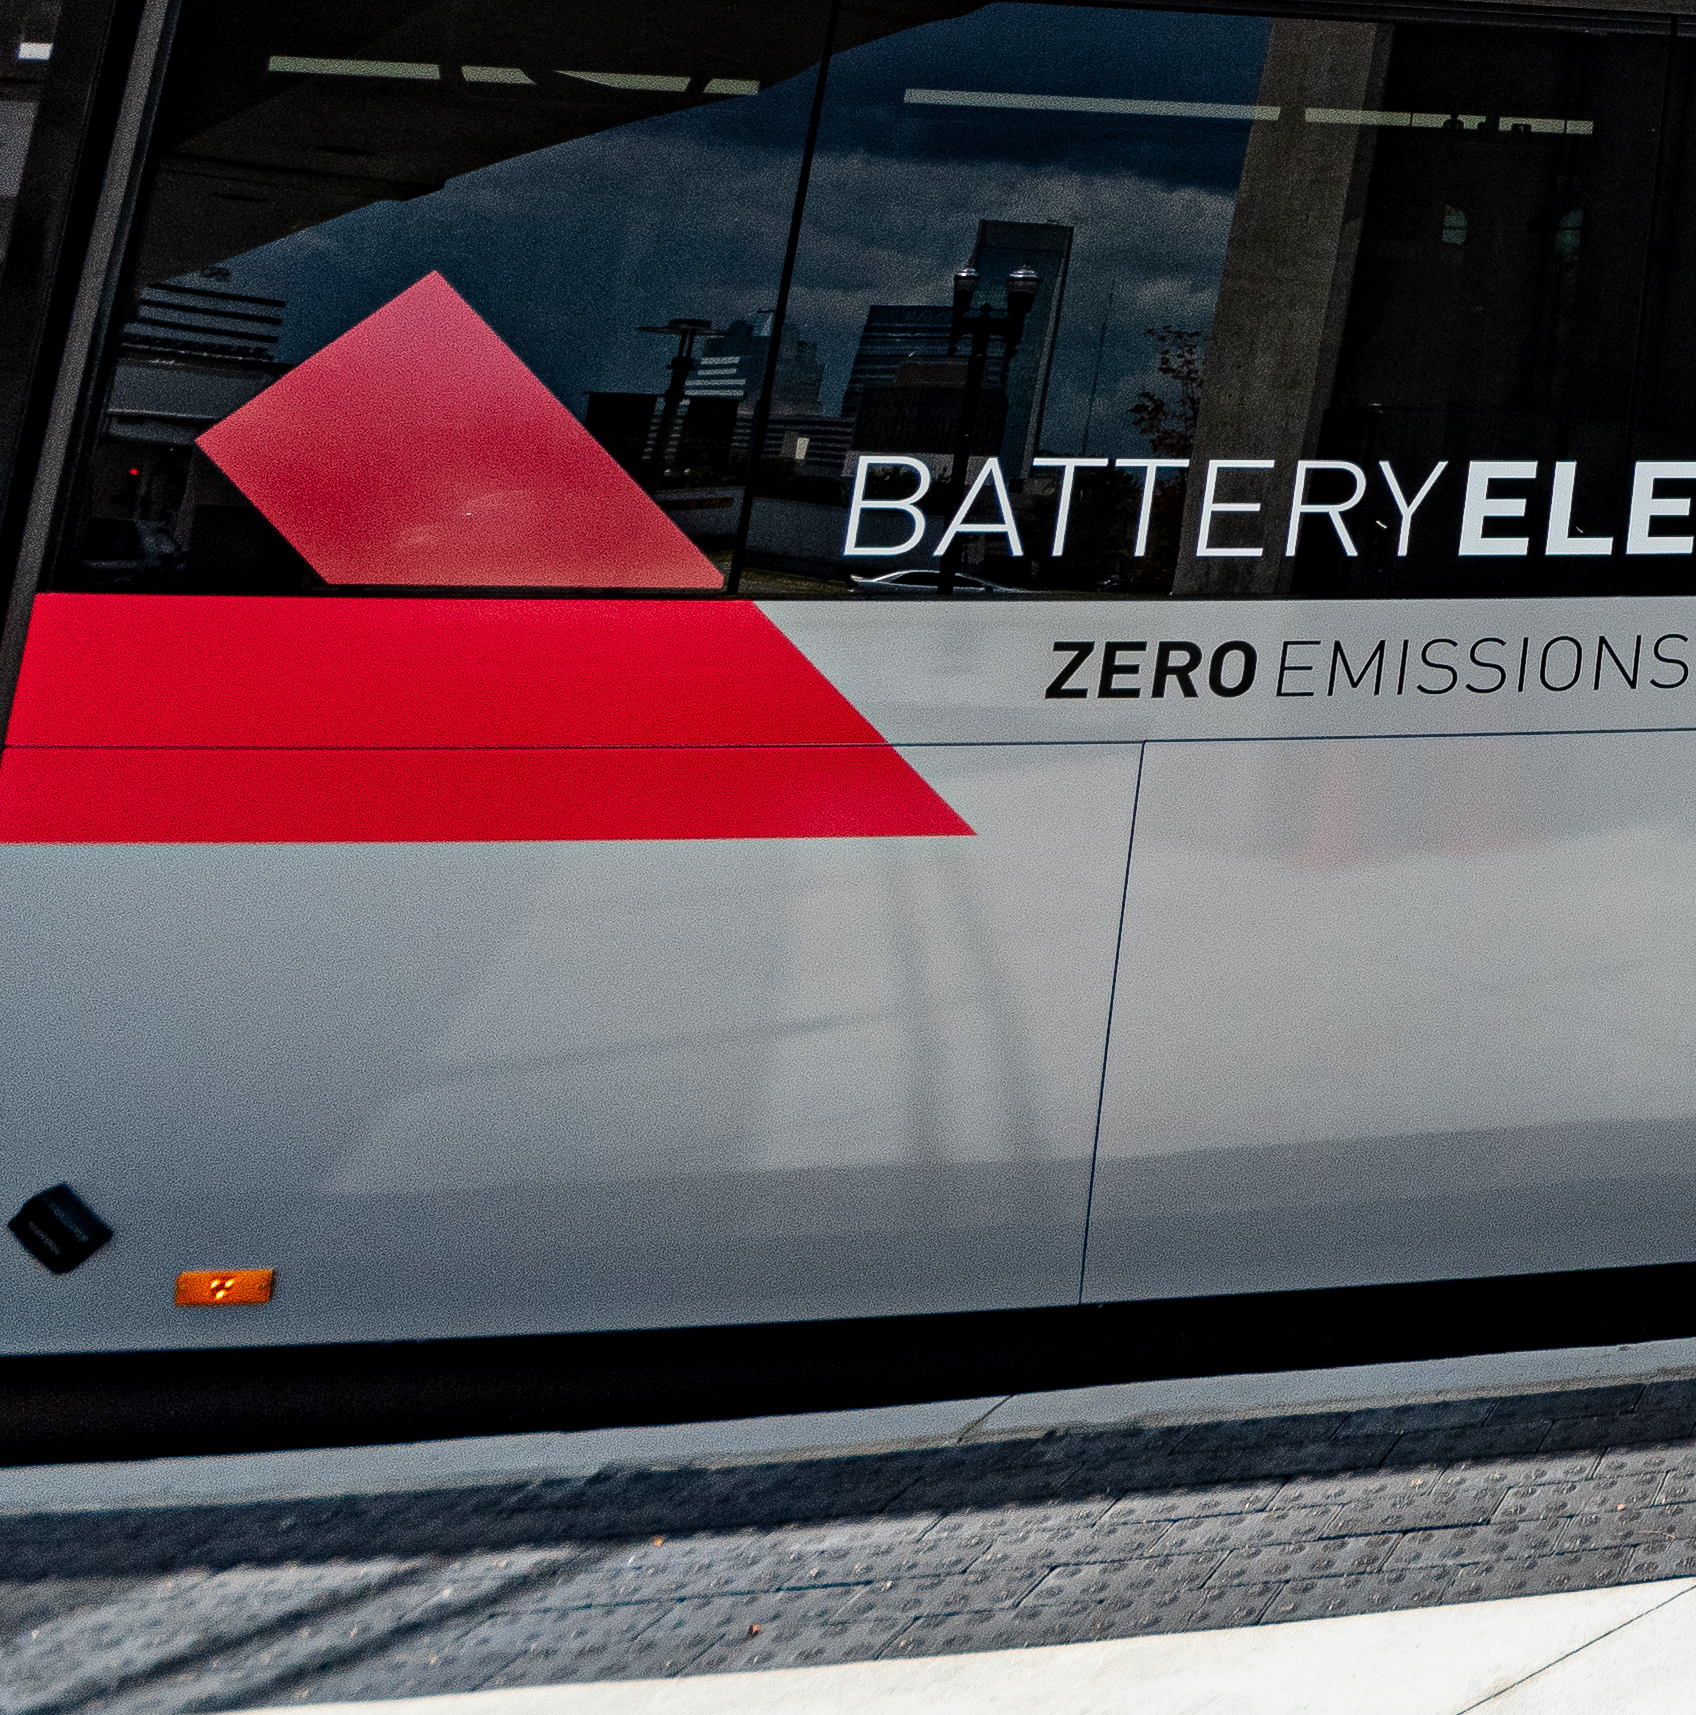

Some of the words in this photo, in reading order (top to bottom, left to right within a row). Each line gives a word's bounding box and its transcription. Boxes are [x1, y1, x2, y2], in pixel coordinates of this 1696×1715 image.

[843, 455, 1449, 558] BATTERY
[1044, 640, 1258, 699] ZERO
[1276, 633, 1691, 699] EMISSIONS
